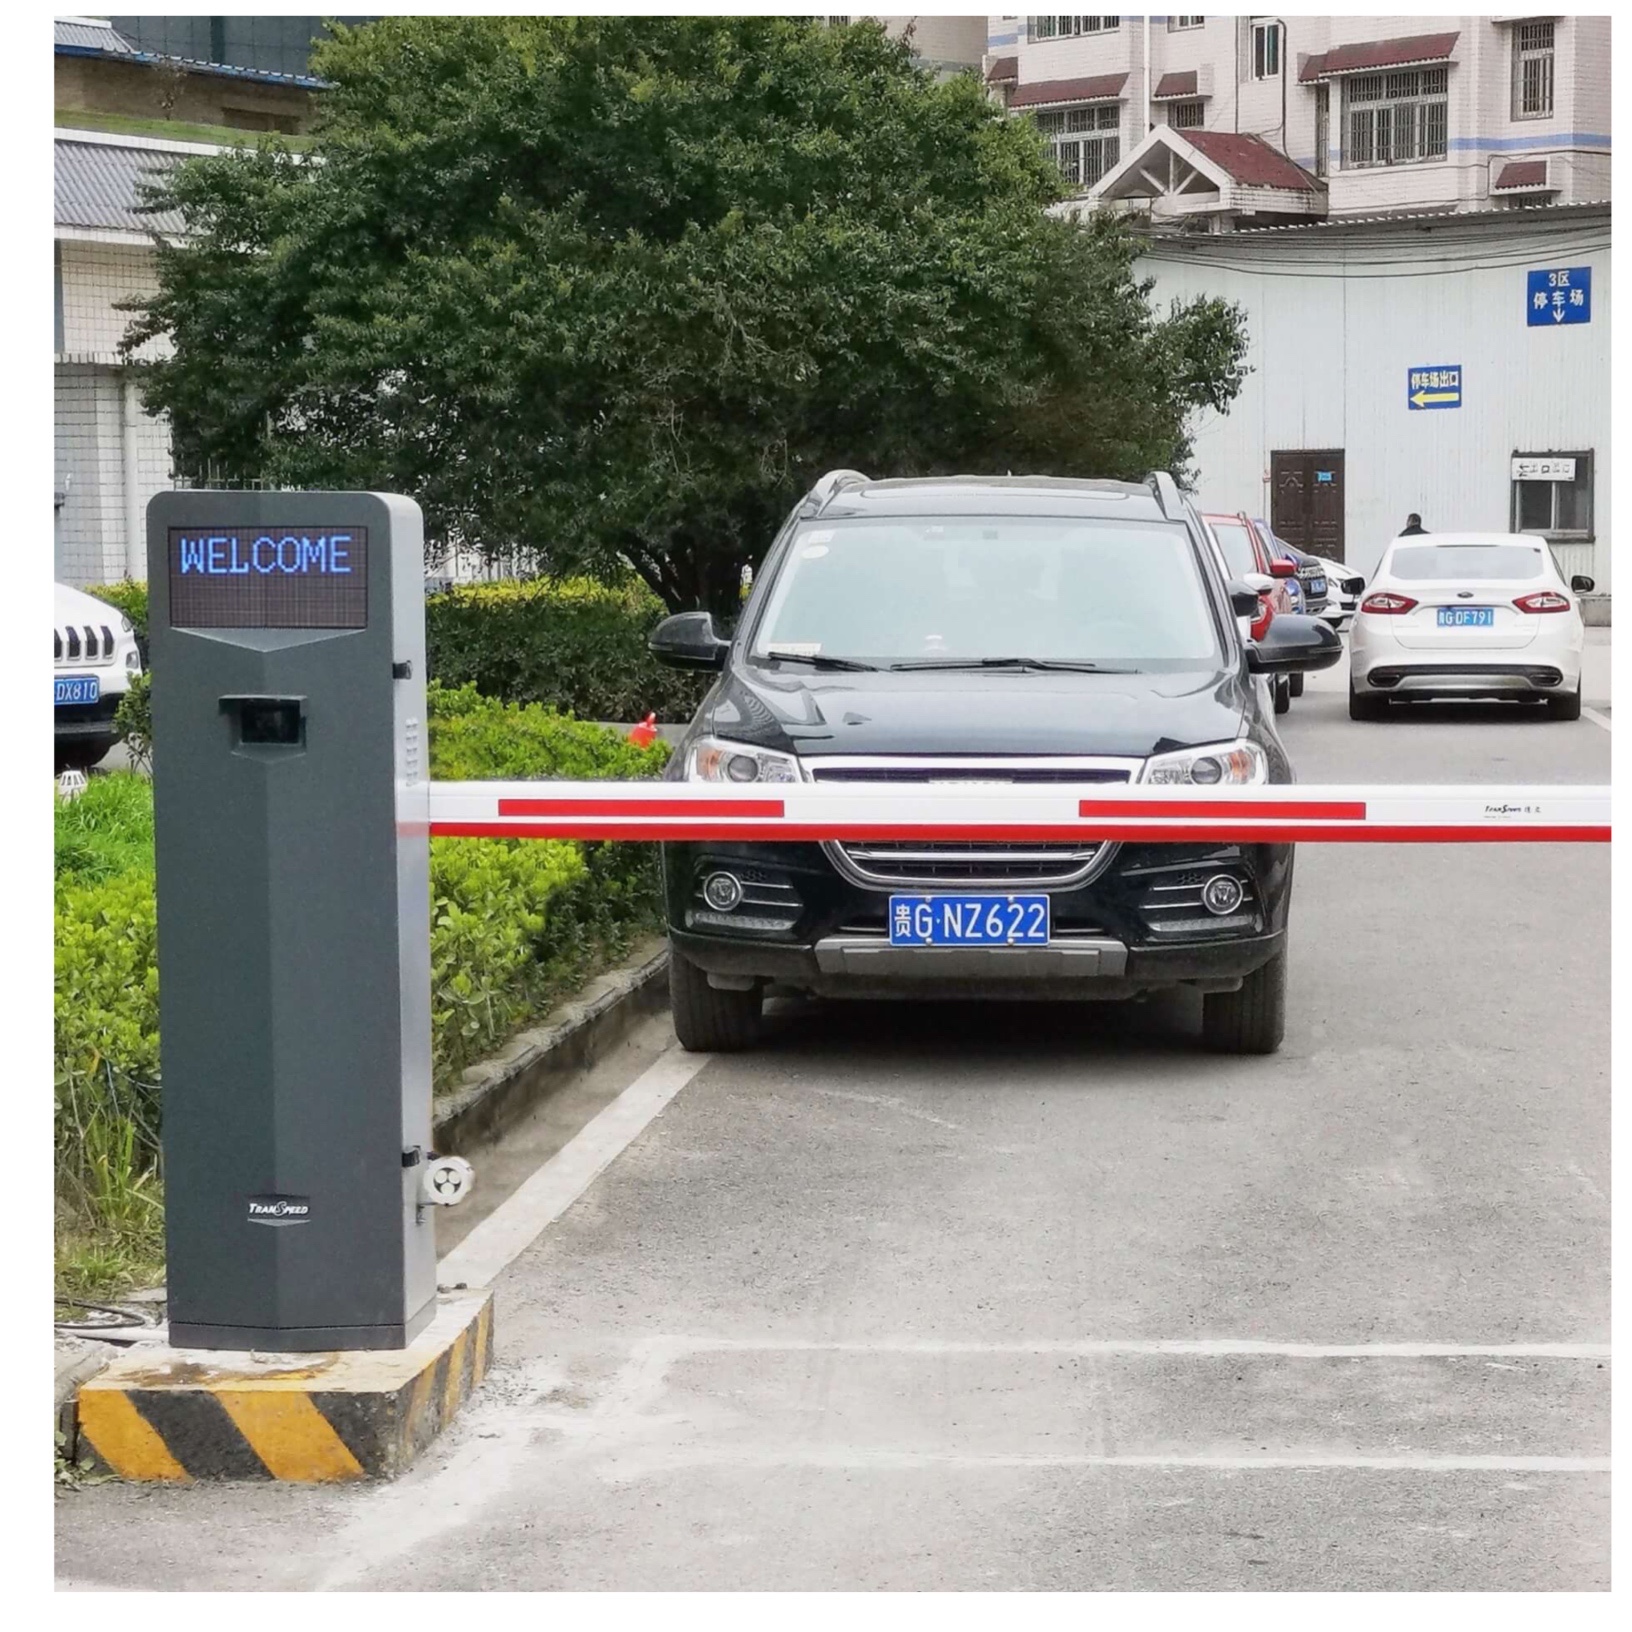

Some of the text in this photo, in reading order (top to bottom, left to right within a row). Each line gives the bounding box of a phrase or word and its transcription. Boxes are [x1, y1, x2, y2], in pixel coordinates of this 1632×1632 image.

[1549, 270, 1571, 287] 3区
[1533, 289, 1584, 309] 停车场
[1411, 370, 1459, 389] 停车场出口
[180, 536, 352, 574] WELCOME
[894, 903, 1045, 939] 贵G·NZ622
